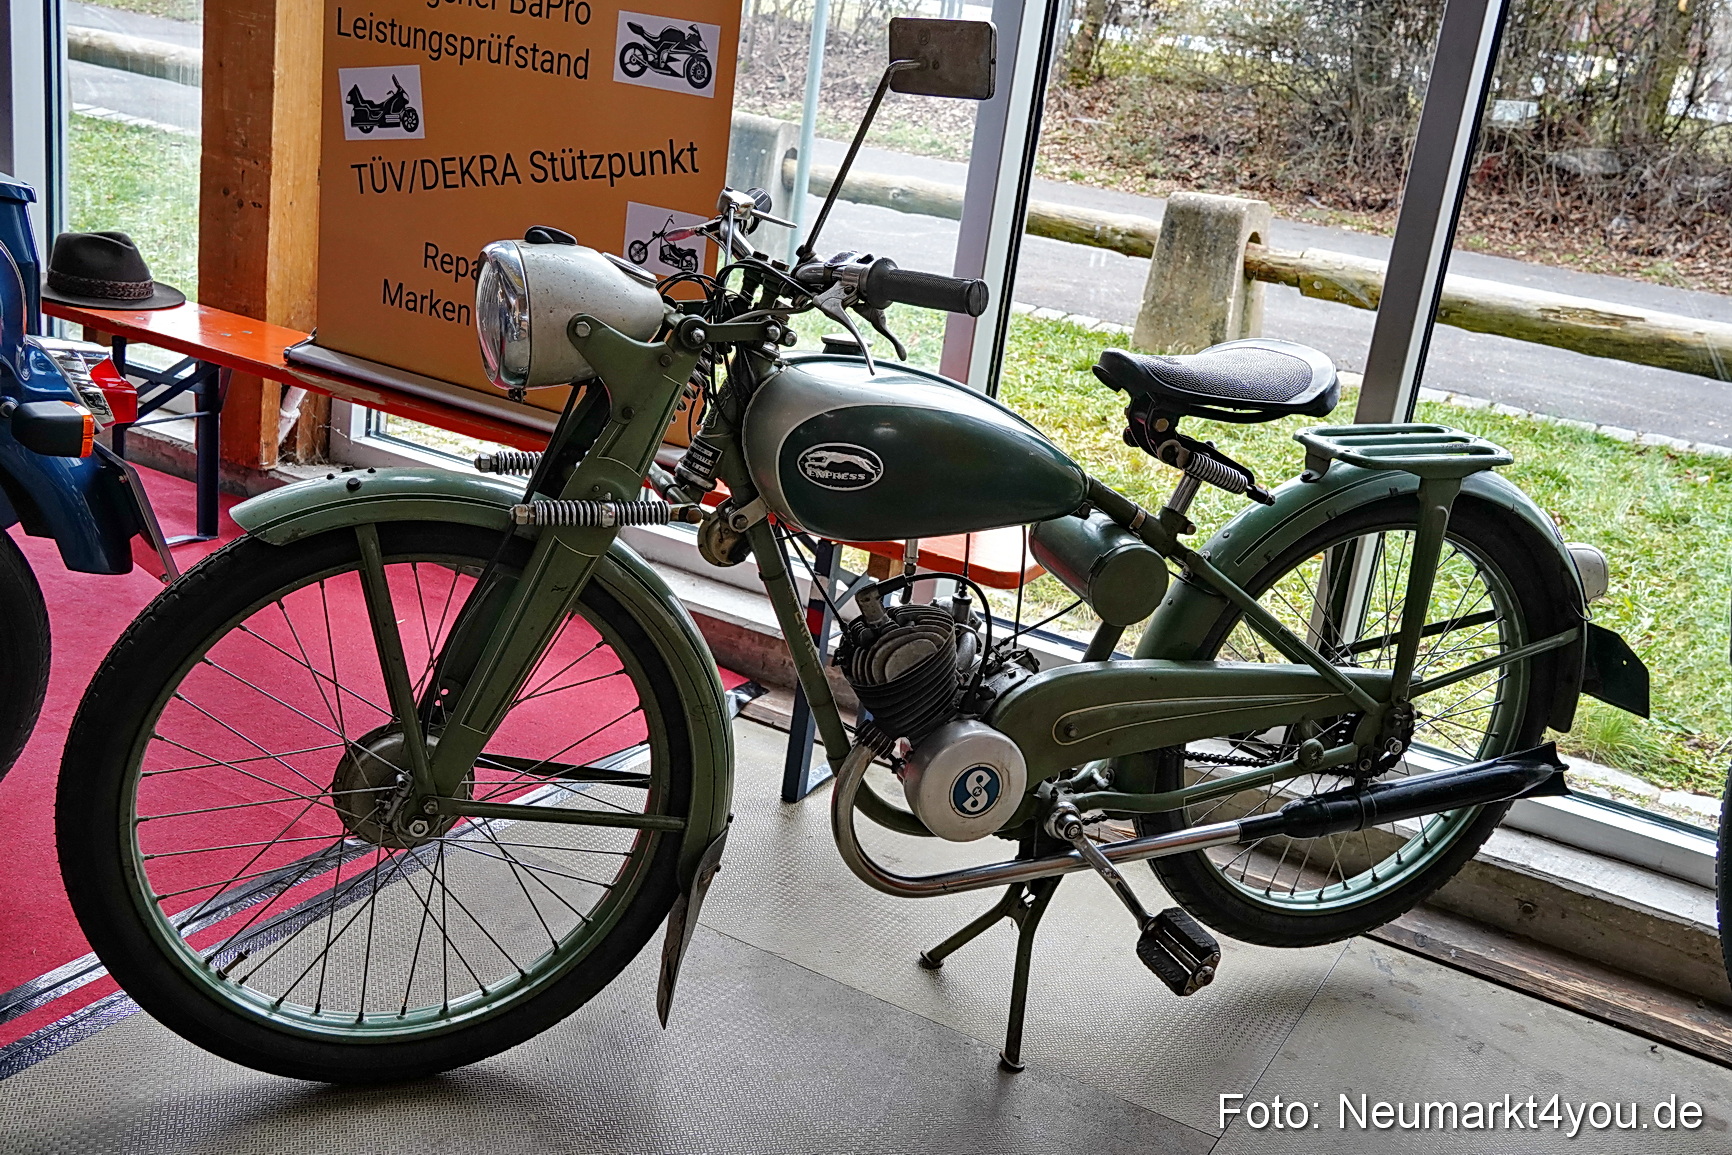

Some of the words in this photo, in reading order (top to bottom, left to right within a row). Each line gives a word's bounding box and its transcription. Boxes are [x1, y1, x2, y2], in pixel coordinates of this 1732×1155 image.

[337, 6, 591, 81] Leistungsprüfstand
[351, 152, 522, 195] TÜV/DEKRA
[529, 138, 700, 188] Stützpunkt
[382, 278, 471, 327] Marken
